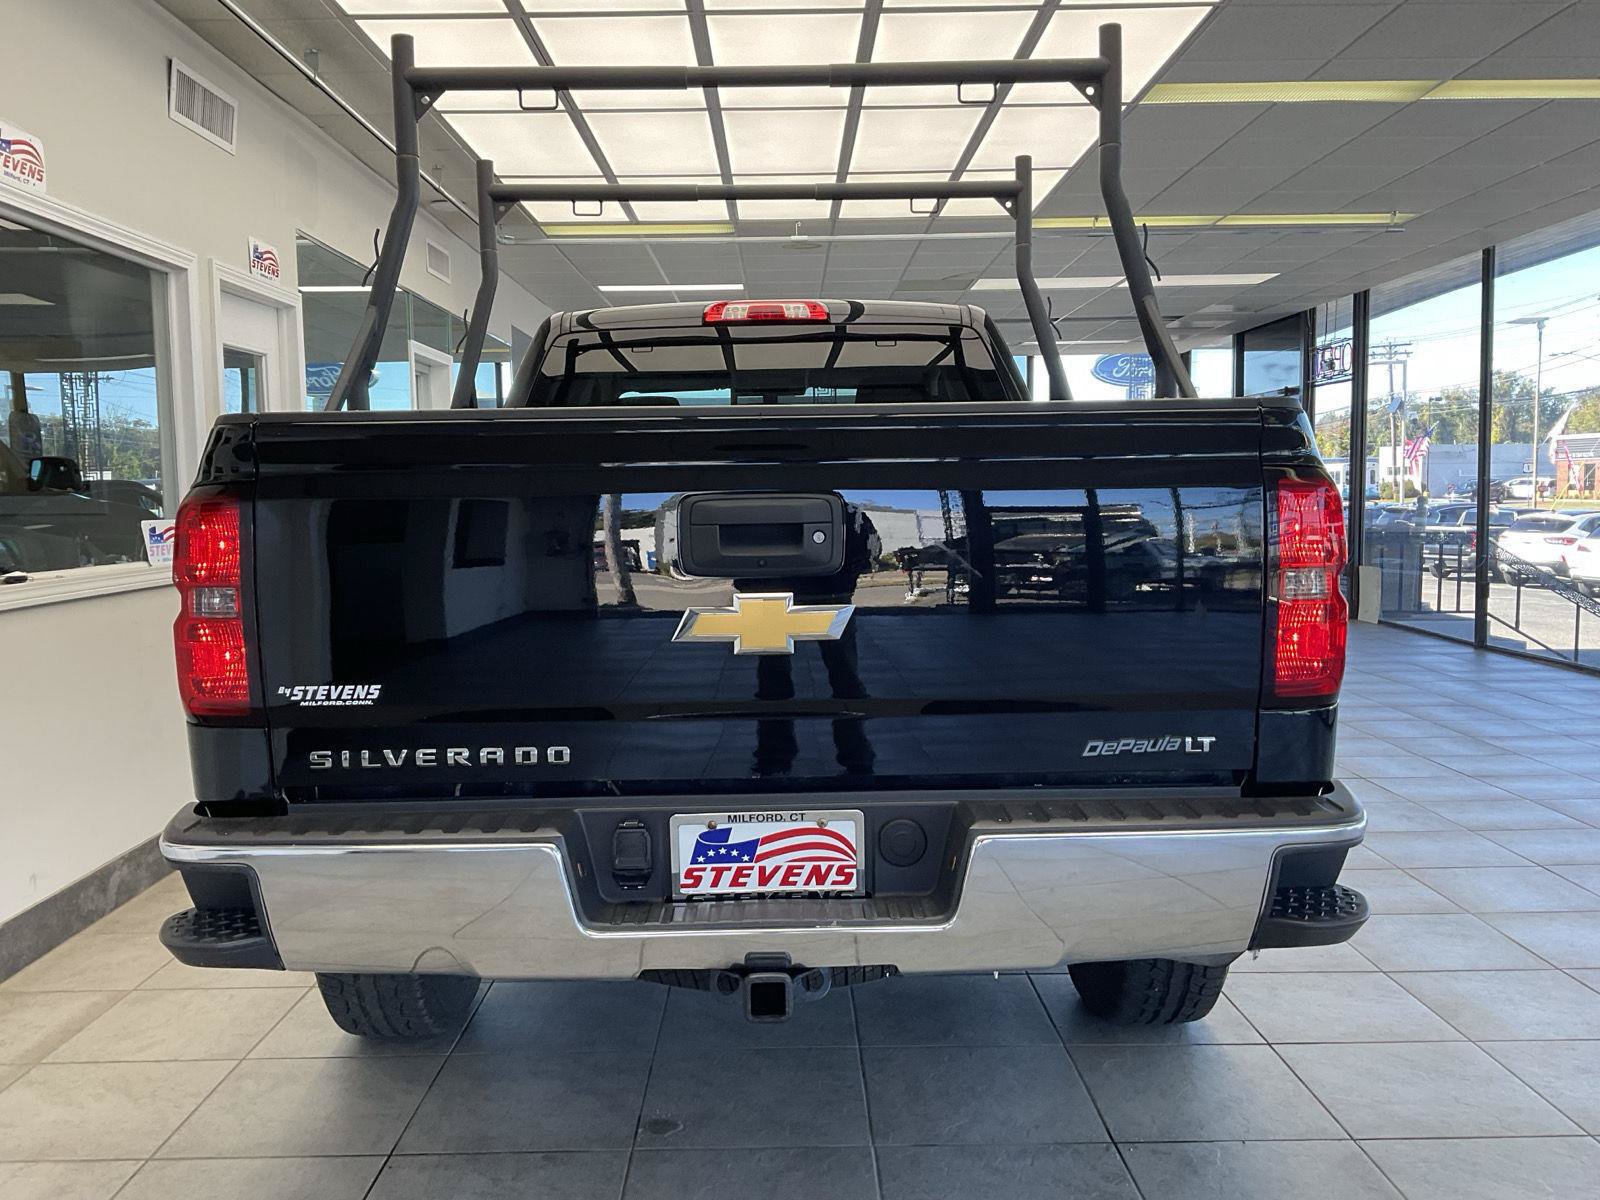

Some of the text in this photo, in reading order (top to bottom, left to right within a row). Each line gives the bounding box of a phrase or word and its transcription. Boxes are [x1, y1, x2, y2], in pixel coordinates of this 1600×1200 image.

[0, 152, 44, 182] EVENS
[252, 259, 279, 278] STEVENS
[150, 543, 174, 557] STEV
[290, 684, 381, 700] STEVENS
[1083, 736, 1216, 757] DePaula LT
[309, 746, 571, 769] SILVERADO
[789, 812, 807, 822] CT
[680, 864, 857, 888] STEVENS
